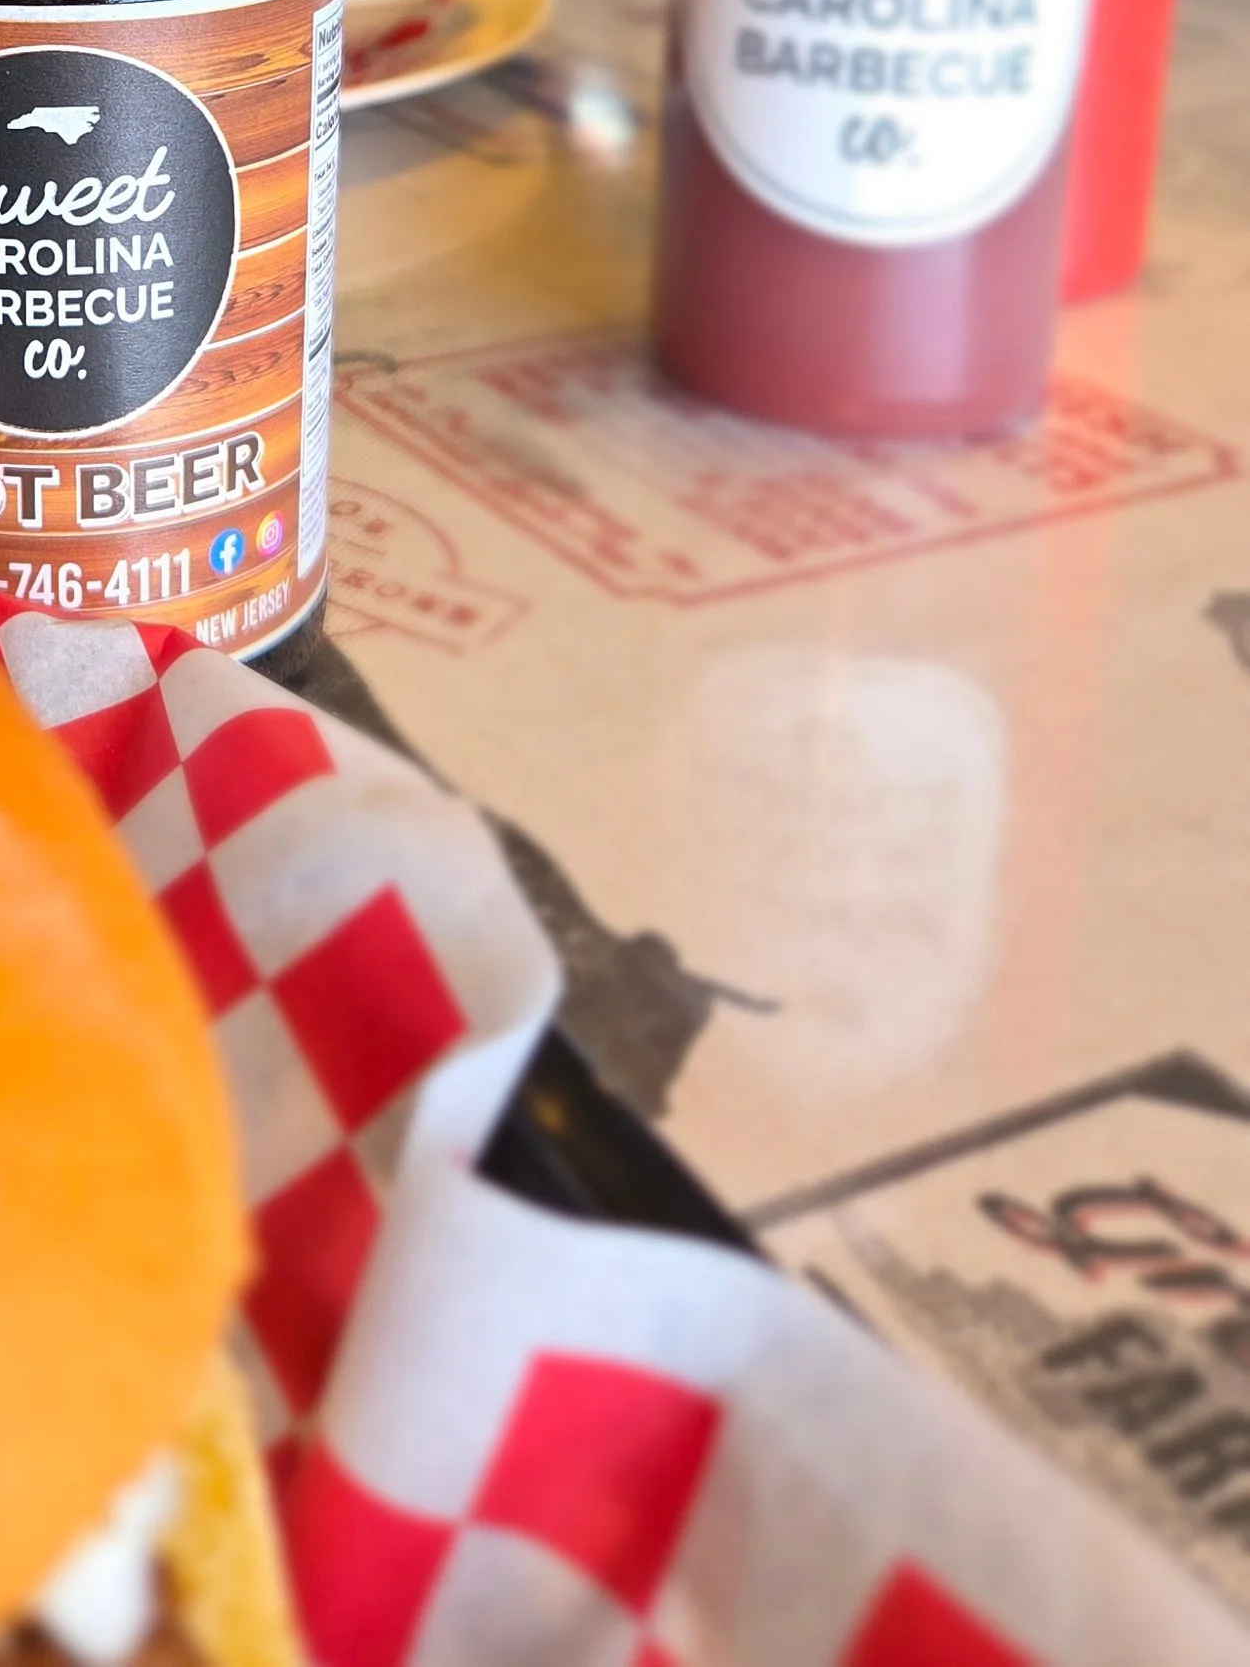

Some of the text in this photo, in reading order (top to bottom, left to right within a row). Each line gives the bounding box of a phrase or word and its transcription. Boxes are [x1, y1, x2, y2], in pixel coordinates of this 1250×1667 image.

[734, 27, 1033, 97] BARBECUE
[75, 430, 267, 527] BEER
[195, 605, 238, 647] NEW
[240, 575, 290, 632] JERSEY
[1041, 1314, 1250, 1549] FAR
